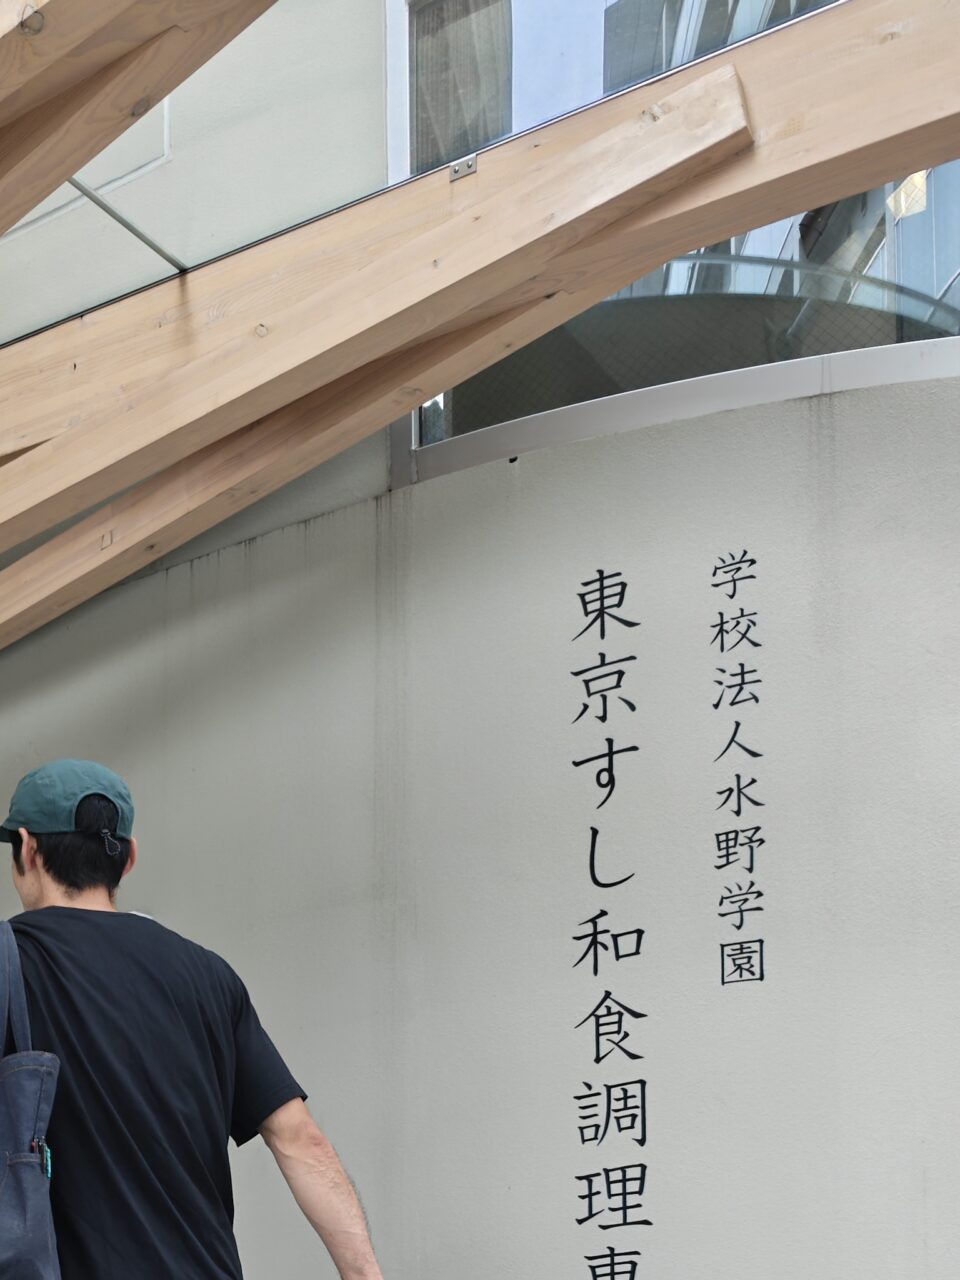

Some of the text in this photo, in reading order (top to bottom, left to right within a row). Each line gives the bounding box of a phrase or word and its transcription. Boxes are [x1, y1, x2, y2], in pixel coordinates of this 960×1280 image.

[711, 550, 765, 985] 学校法人水野学園
